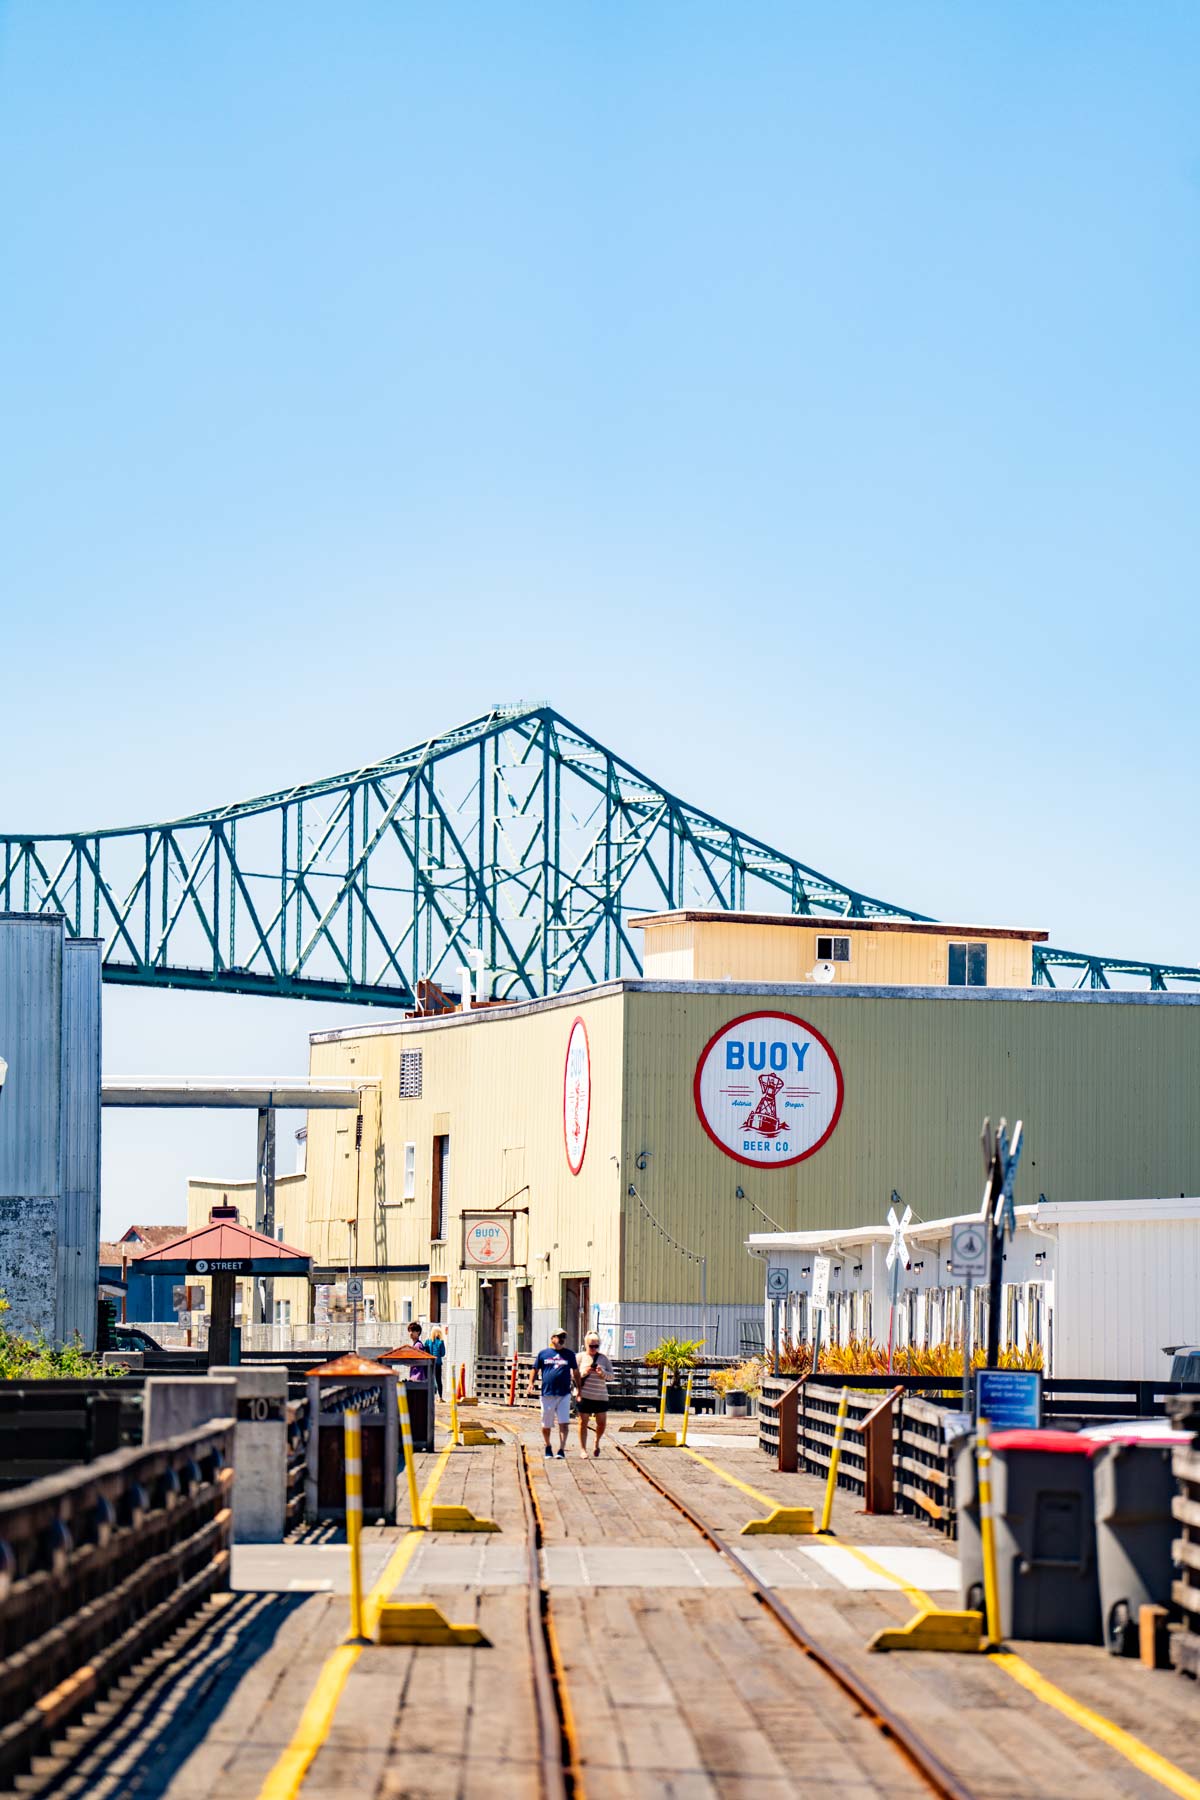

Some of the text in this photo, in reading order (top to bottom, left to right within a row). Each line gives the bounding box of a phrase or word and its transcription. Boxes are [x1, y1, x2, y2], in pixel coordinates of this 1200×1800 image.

[726, 1041, 810, 1072] BUOY
[785, 1101, 805, 1109] Oregon
[743, 1141, 793, 1152] BEER CO.
[475, 1228, 500, 1238] BUOY
[210, 1261, 243, 1270] STREET
[248, 1398, 269, 1420] 10
